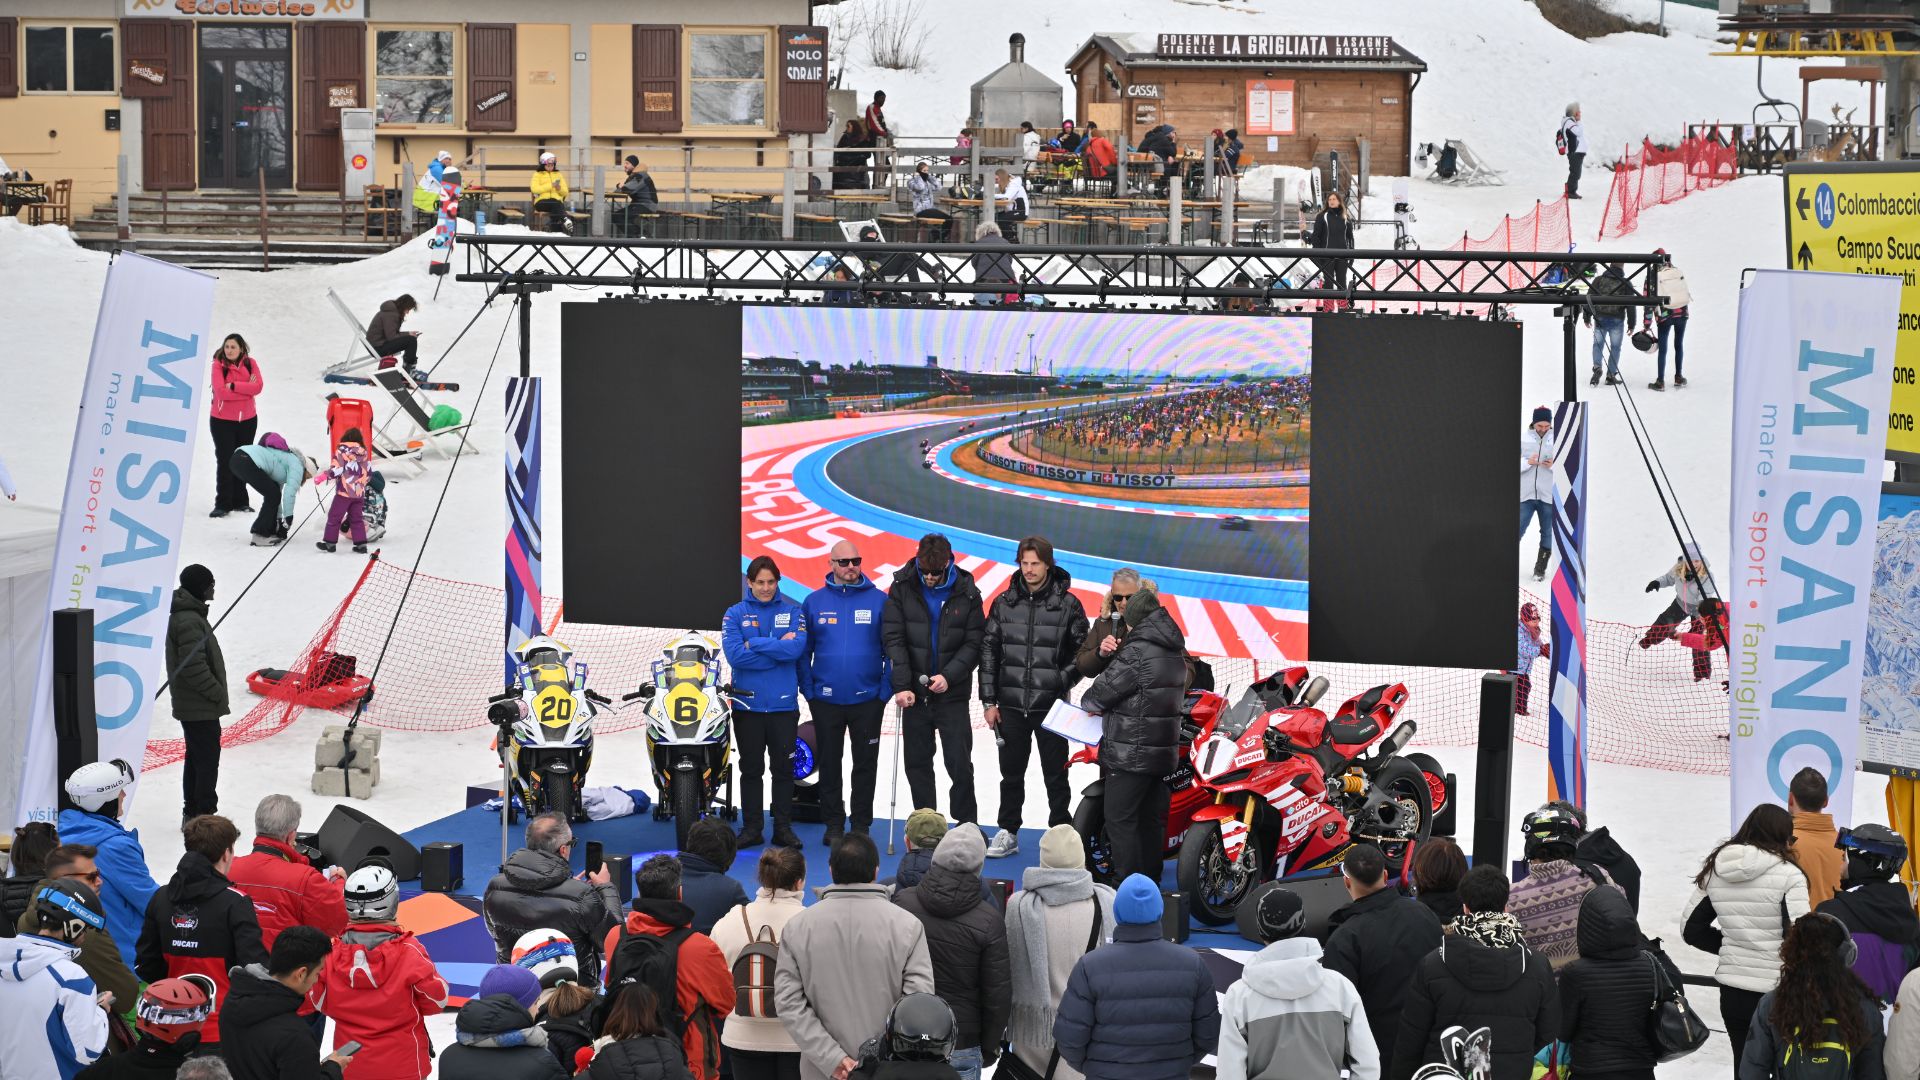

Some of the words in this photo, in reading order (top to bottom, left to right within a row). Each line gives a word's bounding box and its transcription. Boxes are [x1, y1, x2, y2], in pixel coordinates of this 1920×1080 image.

[1162, 34, 1215, 46] POLENTA
[1162, 45, 1216, 55] TIGELLE
[1223, 36, 1241, 55] LA
[1248, 36, 1329, 56] GRIGLIATA
[1336, 36, 1389, 48] LASAGNE
[1336, 47, 1389, 57] ROSETTE
[787, 50, 822, 60] NOLO
[1127, 84, 1159, 97] CASSA
[1816, 191, 1833, 222] 14
[1837, 235, 1883, 265] Campo
[100, 372, 123, 437] mare
[1757, 404, 1778, 476] mare
[988, 452, 1017, 470] TISSOT
[1036, 465, 1087, 482] TISSOT
[1115, 474, 1176, 487] TISSOT
[82, 466, 105, 533] sport
[94, 319, 199, 731] MISANO
[1747, 511, 1769, 587] sport
[1766, 340, 1875, 808] MISANO
[1737, 622, 1766, 739] famiglia
[540, 696, 571, 723] 20
[674, 696, 699, 722] 6
[1203, 739, 1221, 776] 1
[1237, 752, 1263, 766] DUCATI
[1295, 798, 1310, 811] dto
[1276, 854, 1289, 880] 1
[71, 904, 100, 925] HEAD
[172, 939, 199, 949] DUCATI
[920, 1033, 930, 1041] XL
